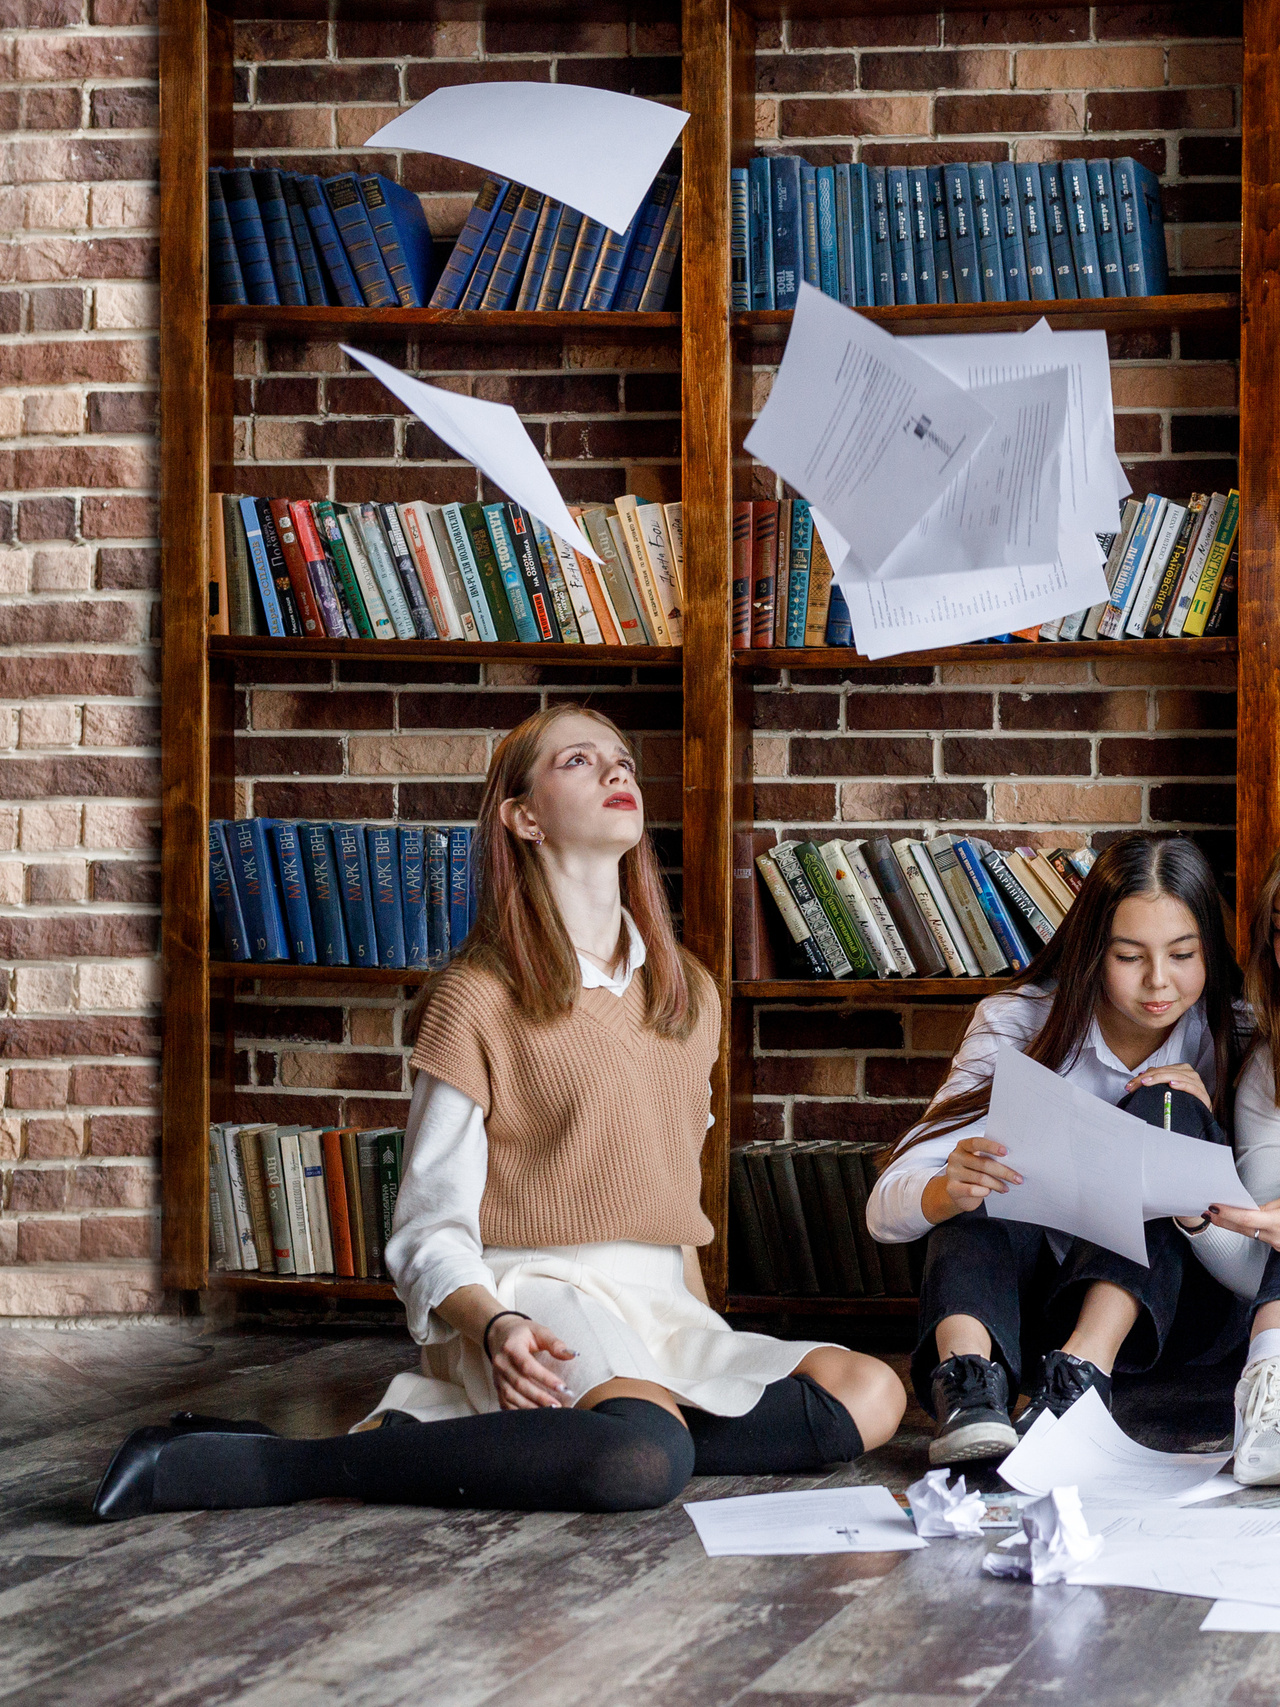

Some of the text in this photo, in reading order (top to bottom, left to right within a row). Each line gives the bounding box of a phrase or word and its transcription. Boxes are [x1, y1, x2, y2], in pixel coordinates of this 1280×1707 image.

[881, 272, 889, 282] 2
[901, 272, 909, 282] 3
[920, 271, 929, 280] 4
[942, 270, 949, 280] 5
[962, 268, 969, 278] 7
[985, 268, 994, 278] 8
[1009, 268, 1018, 277] 9
[1030, 266, 1044, 276] 10
[1057, 266, 1070, 275] 13
[1082, 264, 1094, 274] 11
[1104, 264, 1118, 274] 12
[1128, 264, 1140, 273] 15
[776, 269, 786, 296] ТВОЕ
[786, 270, 794, 293] ИМЯ
[264, 509, 284, 567] Полякова
[487, 510, 512, 572] ДАШКОВА
[446, 509, 480, 598] IBM-PC ДЛЯ ПОЛЬЗОВАТЕЛЕЙ
[522, 552, 532, 577] ОХОТА
[524, 538, 538, 575] ОХОТНИКА
[359, 558, 376, 592] ДЖОДЖО
[484, 562, 494, 577] 3
[658, 552, 676, 587] Диана
[1110, 546, 1138, 604] ЛИТВИНОВЫ
[1152, 545, 1186, 612] ГРАНОВСКИЕ
[1200, 544, 1226, 593] ENGLISH
[252, 541, 281, 634] Марат ОСПАНОВ
[760, 584, 767, 592] 2
[290, 614, 298, 634] Миссия
[387, 590, 406, 637] НАТАЛЬЯ
[656, 626, 663, 636] 5
[210, 825, 230, 896] МАРК ТВЕН
[238, 824, 260, 895] МАРК ТВЕН
[280, 824, 302, 898] МАРК ТВЕН
[310, 826, 330, 900] МАРК ТВЕН
[340, 828, 362, 901] МАРК ТВЕН
[374, 828, 394, 904] МАРК ТВЕН
[404, 830, 422, 904] МАРК ТВЕН
[428, 834, 445, 906] МАРК ТВЕН
[990, 858, 1035, 920] МАРИНИНА
[1004, 869, 1033, 906] АЛЕКСАНДРА
[870, 896, 886, 922] Елена
[232, 938, 238, 951] 3
[257, 937, 266, 950] 10
[296, 941, 304, 953] 11
[837, 916, 859, 954] СЕРЕБРЯНЫЙ
[928, 920, 955, 962] Михайлова
[326, 943, 334, 956] 4
[358, 944, 365, 957] 5
[386, 945, 394, 958] 6
[411, 946, 419, 958] 7
[434, 948, 442, 961] 2
[266, 1156, 280, 1189] Грин
